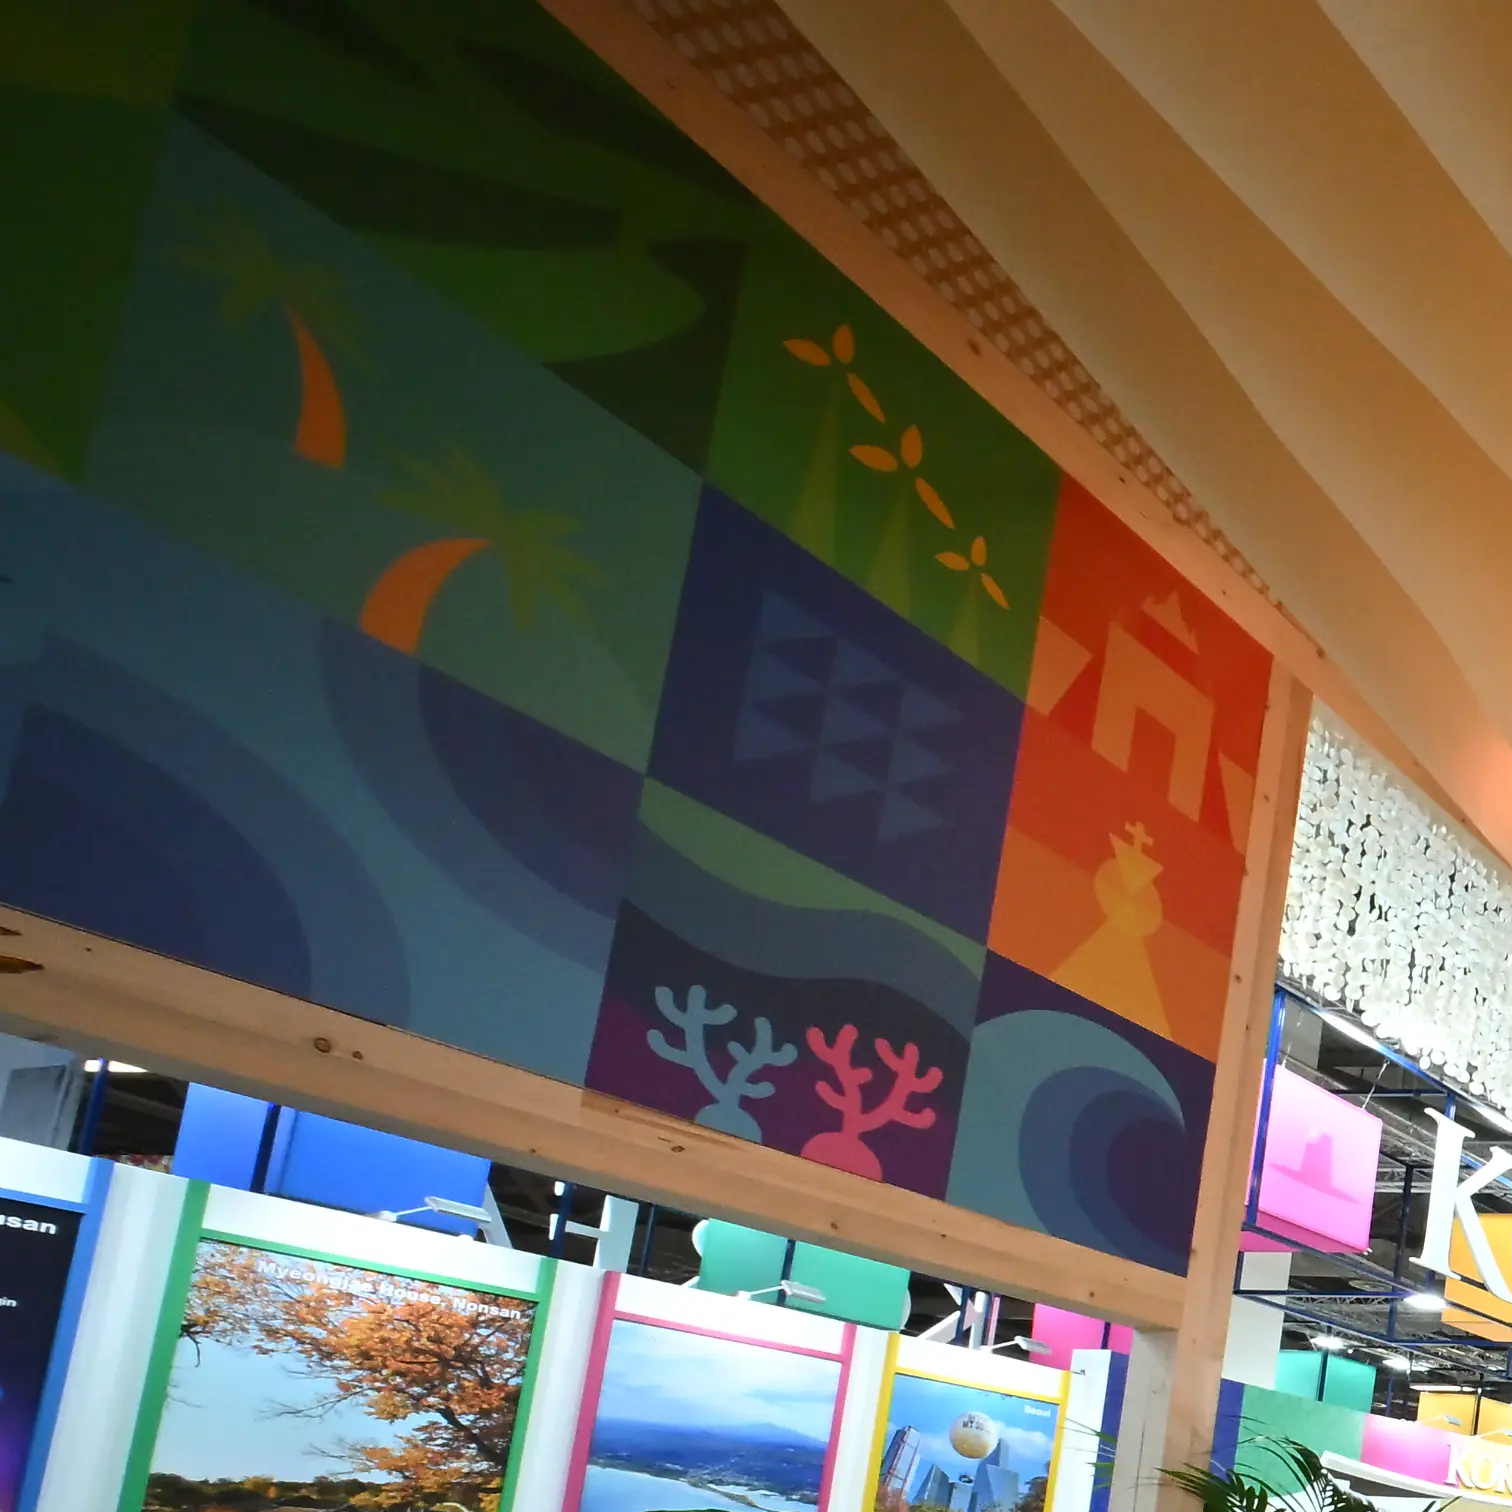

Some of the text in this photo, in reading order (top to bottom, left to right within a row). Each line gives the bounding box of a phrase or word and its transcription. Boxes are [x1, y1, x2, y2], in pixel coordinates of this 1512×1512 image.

[257, 1260, 521, 1320] Myeongjae House, Nonsan
